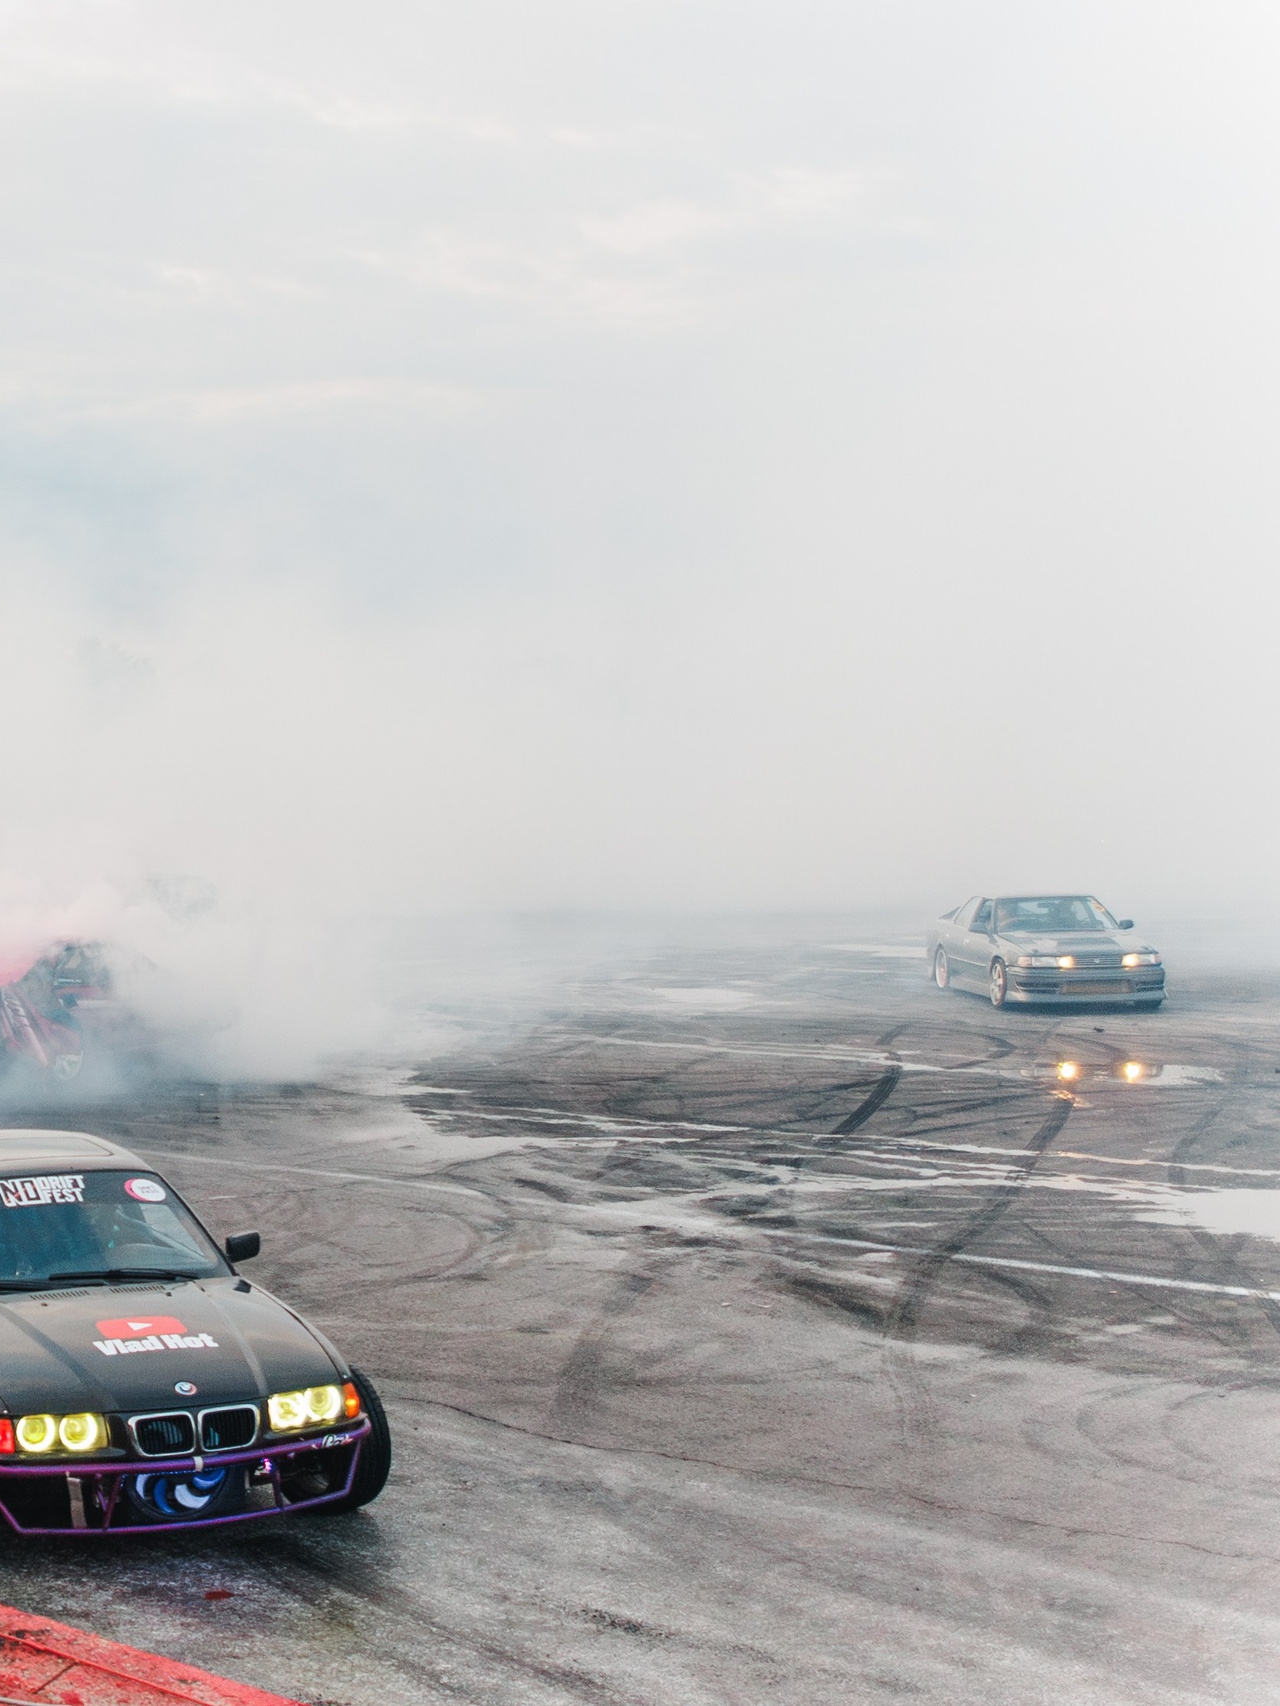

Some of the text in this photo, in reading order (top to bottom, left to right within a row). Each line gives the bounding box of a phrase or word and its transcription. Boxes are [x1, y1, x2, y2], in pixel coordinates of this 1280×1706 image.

[36, 1175, 85, 1190] DRIFT
[42, 1188, 84, 1204] FEST
[92, 1333, 219, 1356] Vlad Hot
